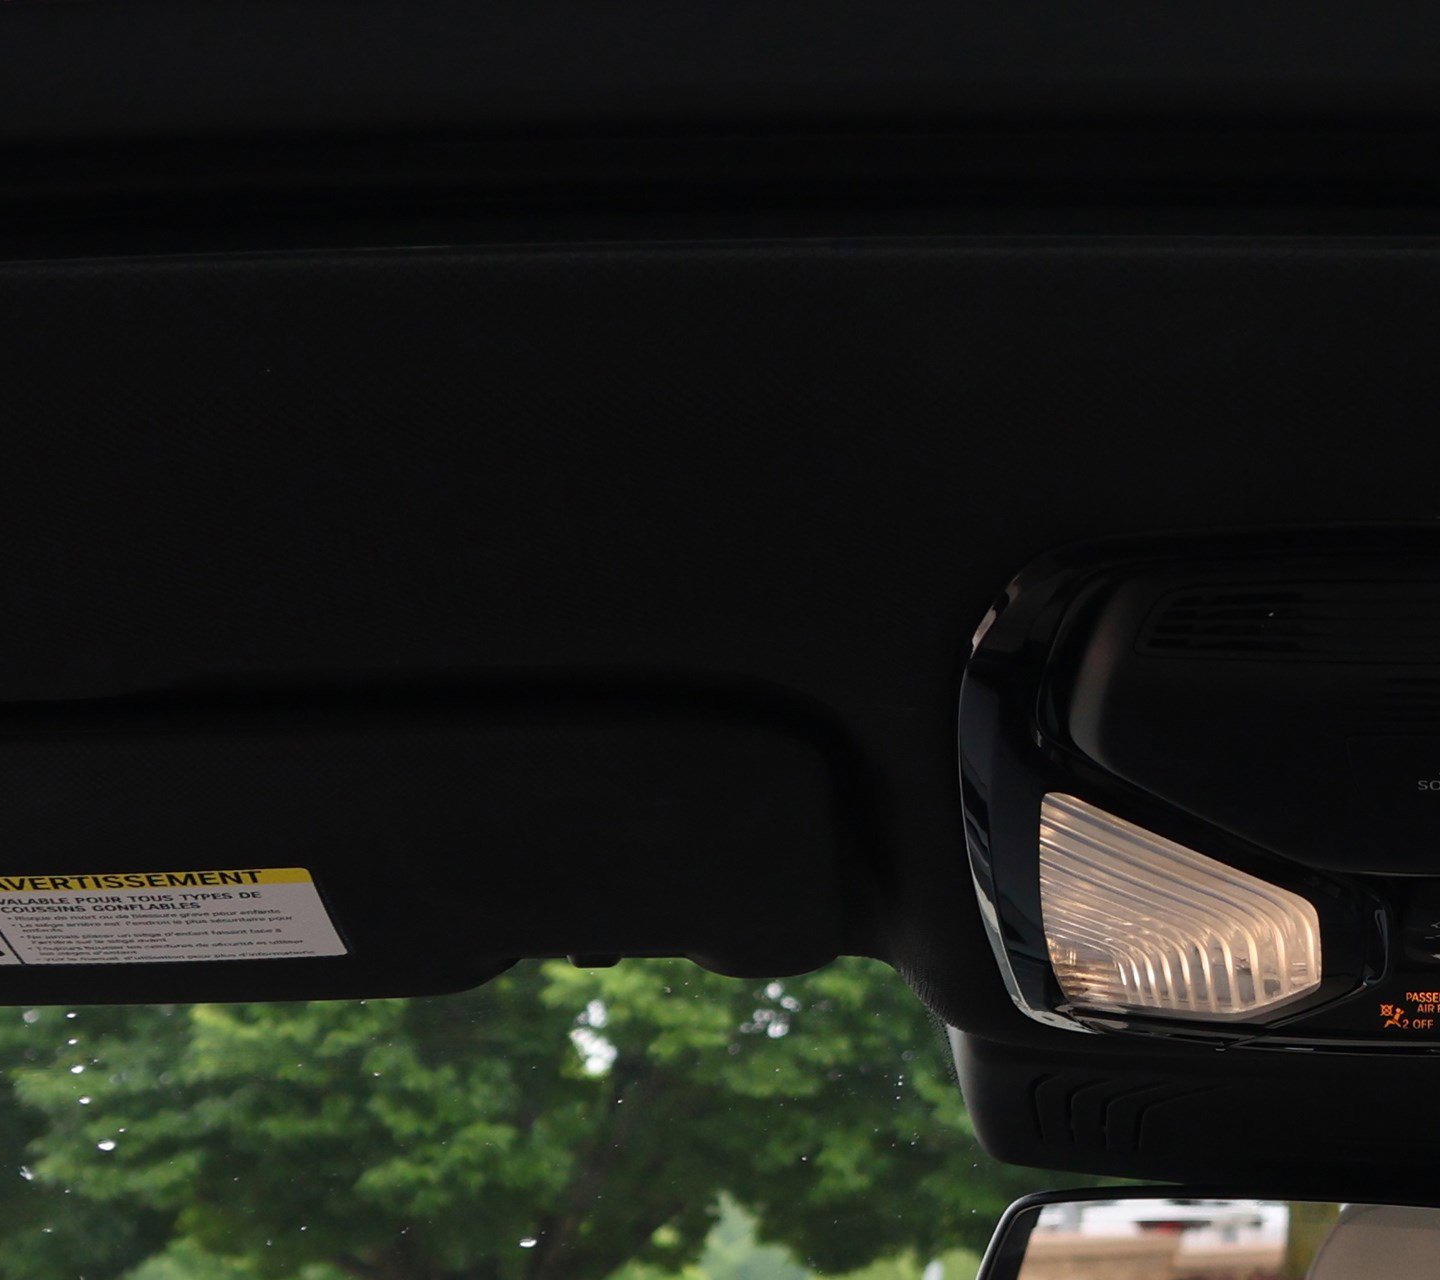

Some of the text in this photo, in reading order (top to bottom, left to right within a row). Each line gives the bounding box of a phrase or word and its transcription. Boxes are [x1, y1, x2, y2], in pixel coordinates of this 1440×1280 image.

[179, 892, 232, 900] TYPES
[93, 902, 200, 912] GONFLABLES
[1417, 1003, 1435, 1013] AIR
[1413, 1020, 1434, 1030] OFF
